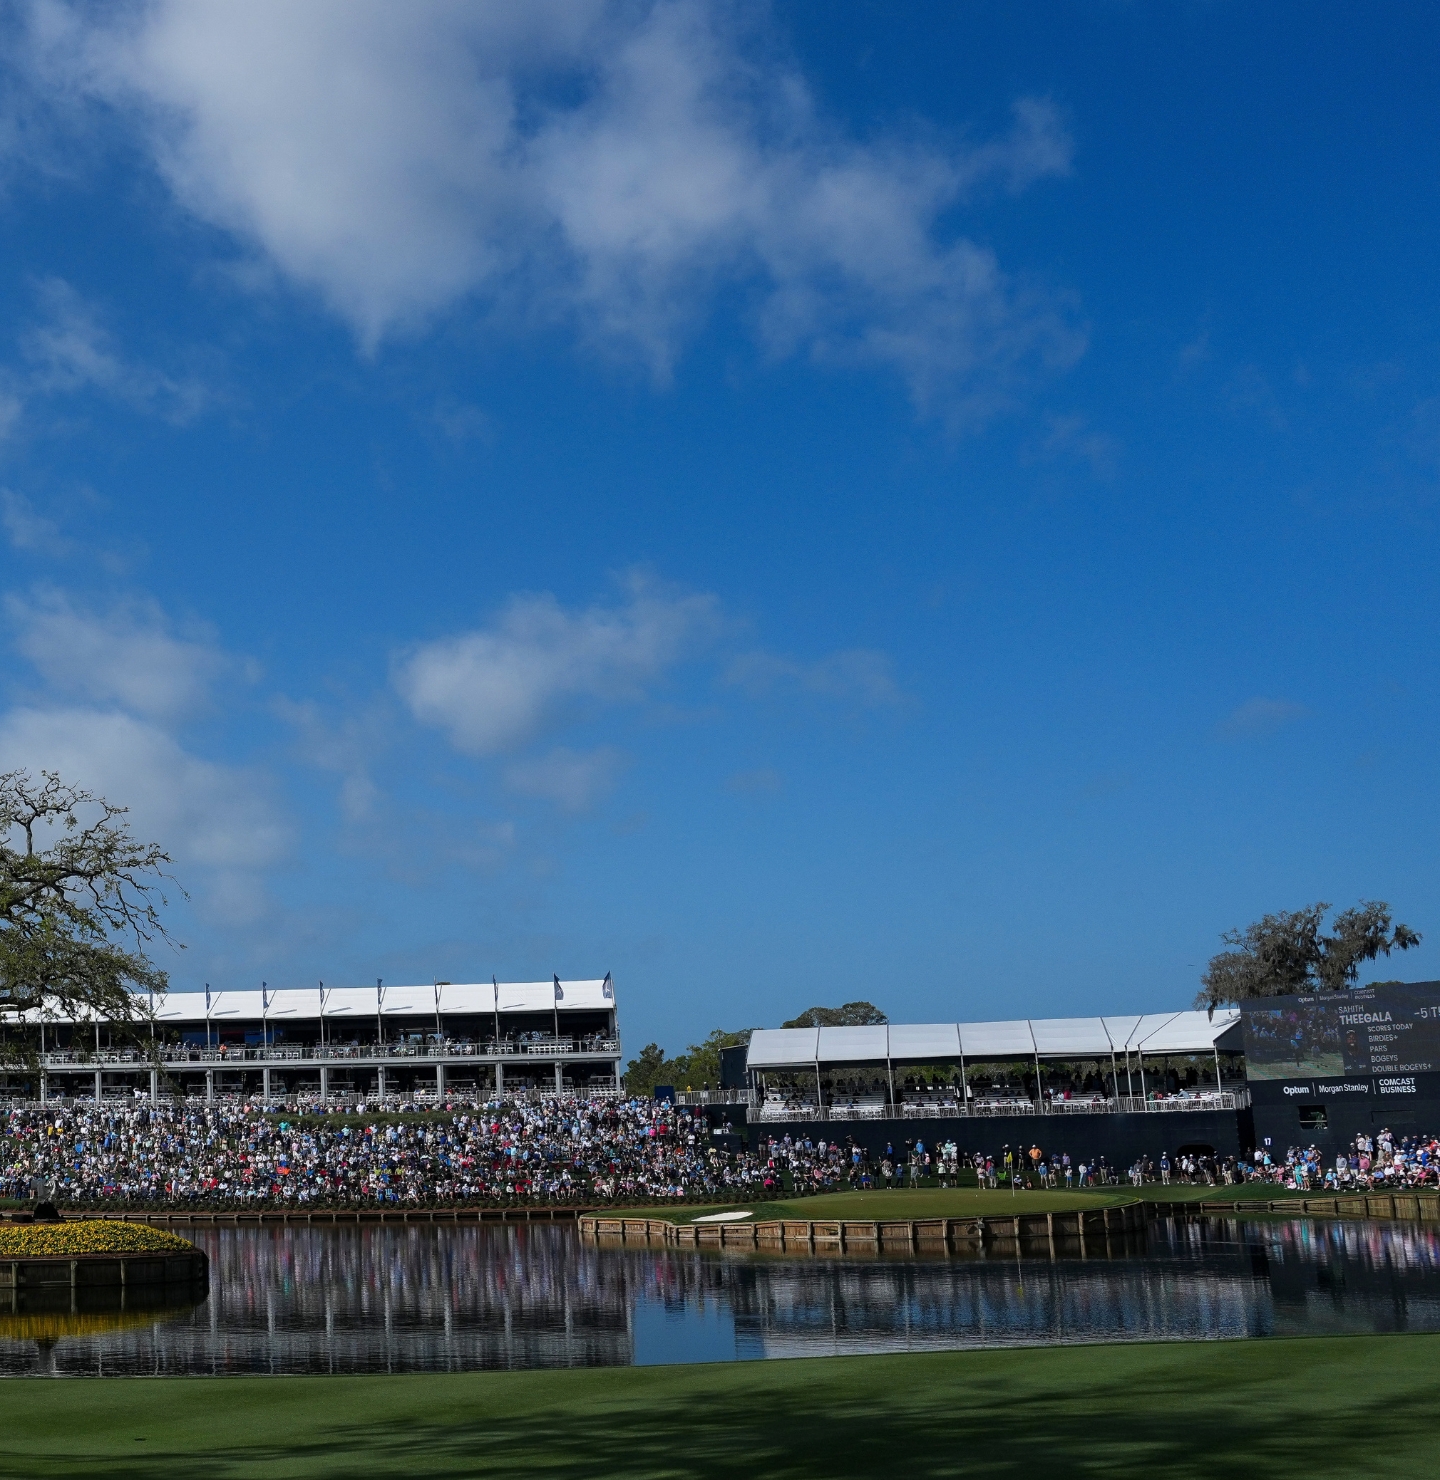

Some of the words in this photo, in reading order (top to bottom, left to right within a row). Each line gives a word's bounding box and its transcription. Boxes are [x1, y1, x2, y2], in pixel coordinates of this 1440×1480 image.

[1338, 1005, 1364, 1014] SAHITH
[1414, 1008, 1428, 1018] -5
[1431, 1006, 1440, 1017] T
[1339, 1012, 1392, 1024] THEEGALA
[1368, 1034, 1398, 1042] BIRDIES+
[1400, 1062, 1432, 1071] BOGEYS+
[1284, 1086, 1309, 1095] Optum
[1319, 1085, 1343, 1094] Morgan
[1344, 1084, 1368, 1093] Stanley
